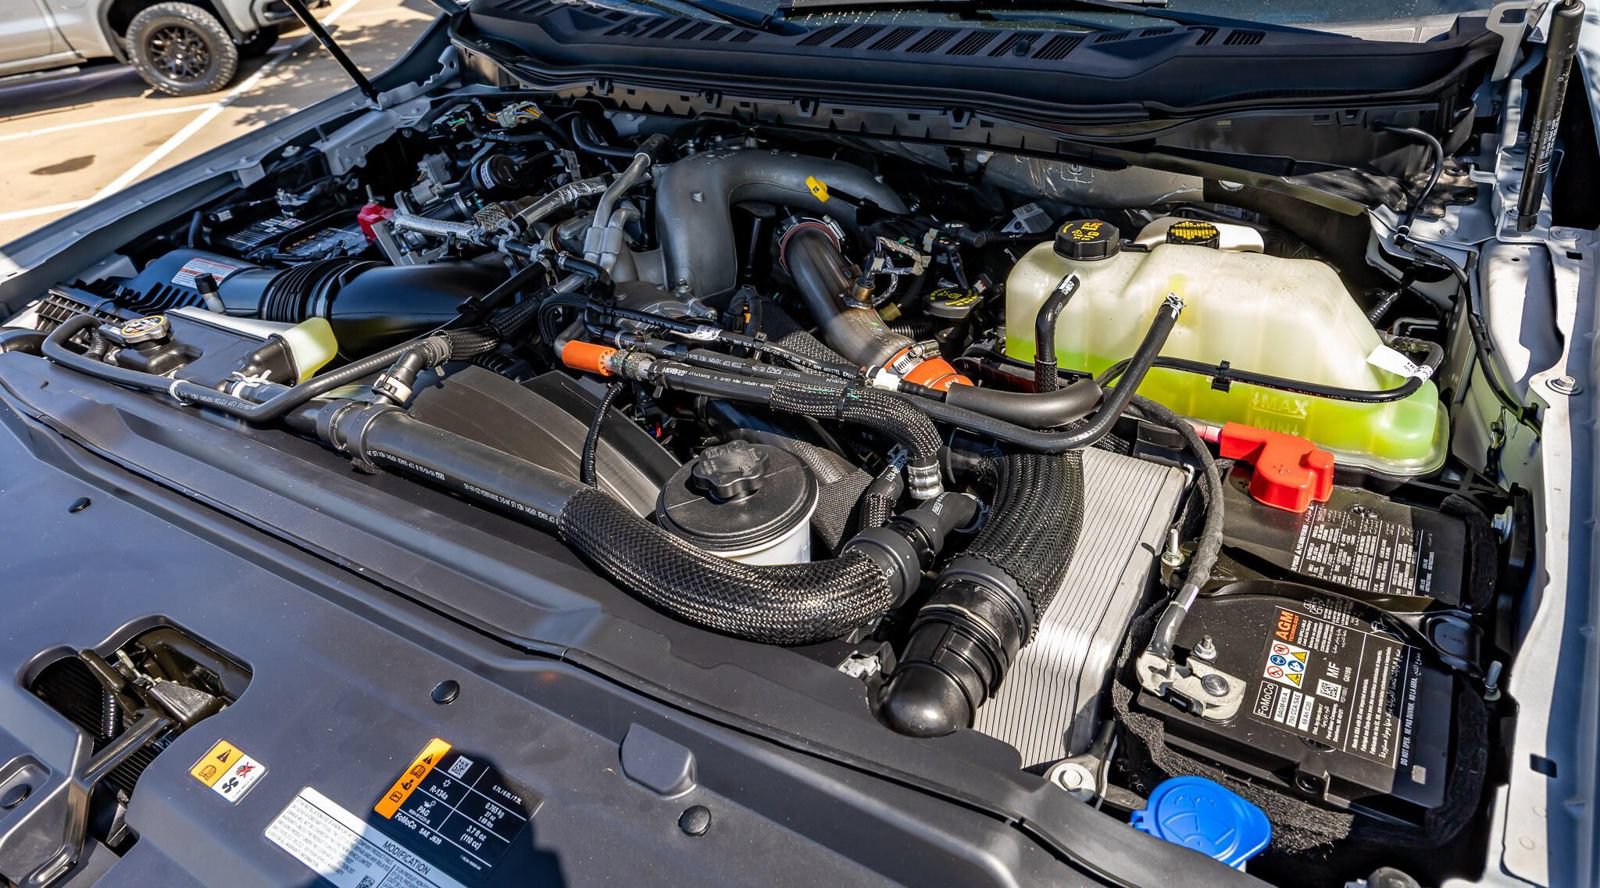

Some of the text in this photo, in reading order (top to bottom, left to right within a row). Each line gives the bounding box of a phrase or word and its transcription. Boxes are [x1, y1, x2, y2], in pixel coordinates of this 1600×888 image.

[1261, 394, 1310, 416] MAX
[1275, 610, 1293, 640] AGM
[1326, 661, 1340, 678] MF
[1257, 682, 1274, 716] FoMoCo
[1400, 757, 1407, 765] DO
[1401, 748, 1409, 758] NOT
[428, 785, 449, 800] R-134a
[416, 805, 430, 816] PAG
[495, 808, 506, 819] kg
[393, 812, 418, 830] FoMoCo
[417, 827, 431, 838] SAE
[465, 825, 476, 834] 3.7
[478, 833, 487, 841] oz
[459, 832, 482, 851] (110 cc)
[381, 840, 431, 875] MODIFICATION
